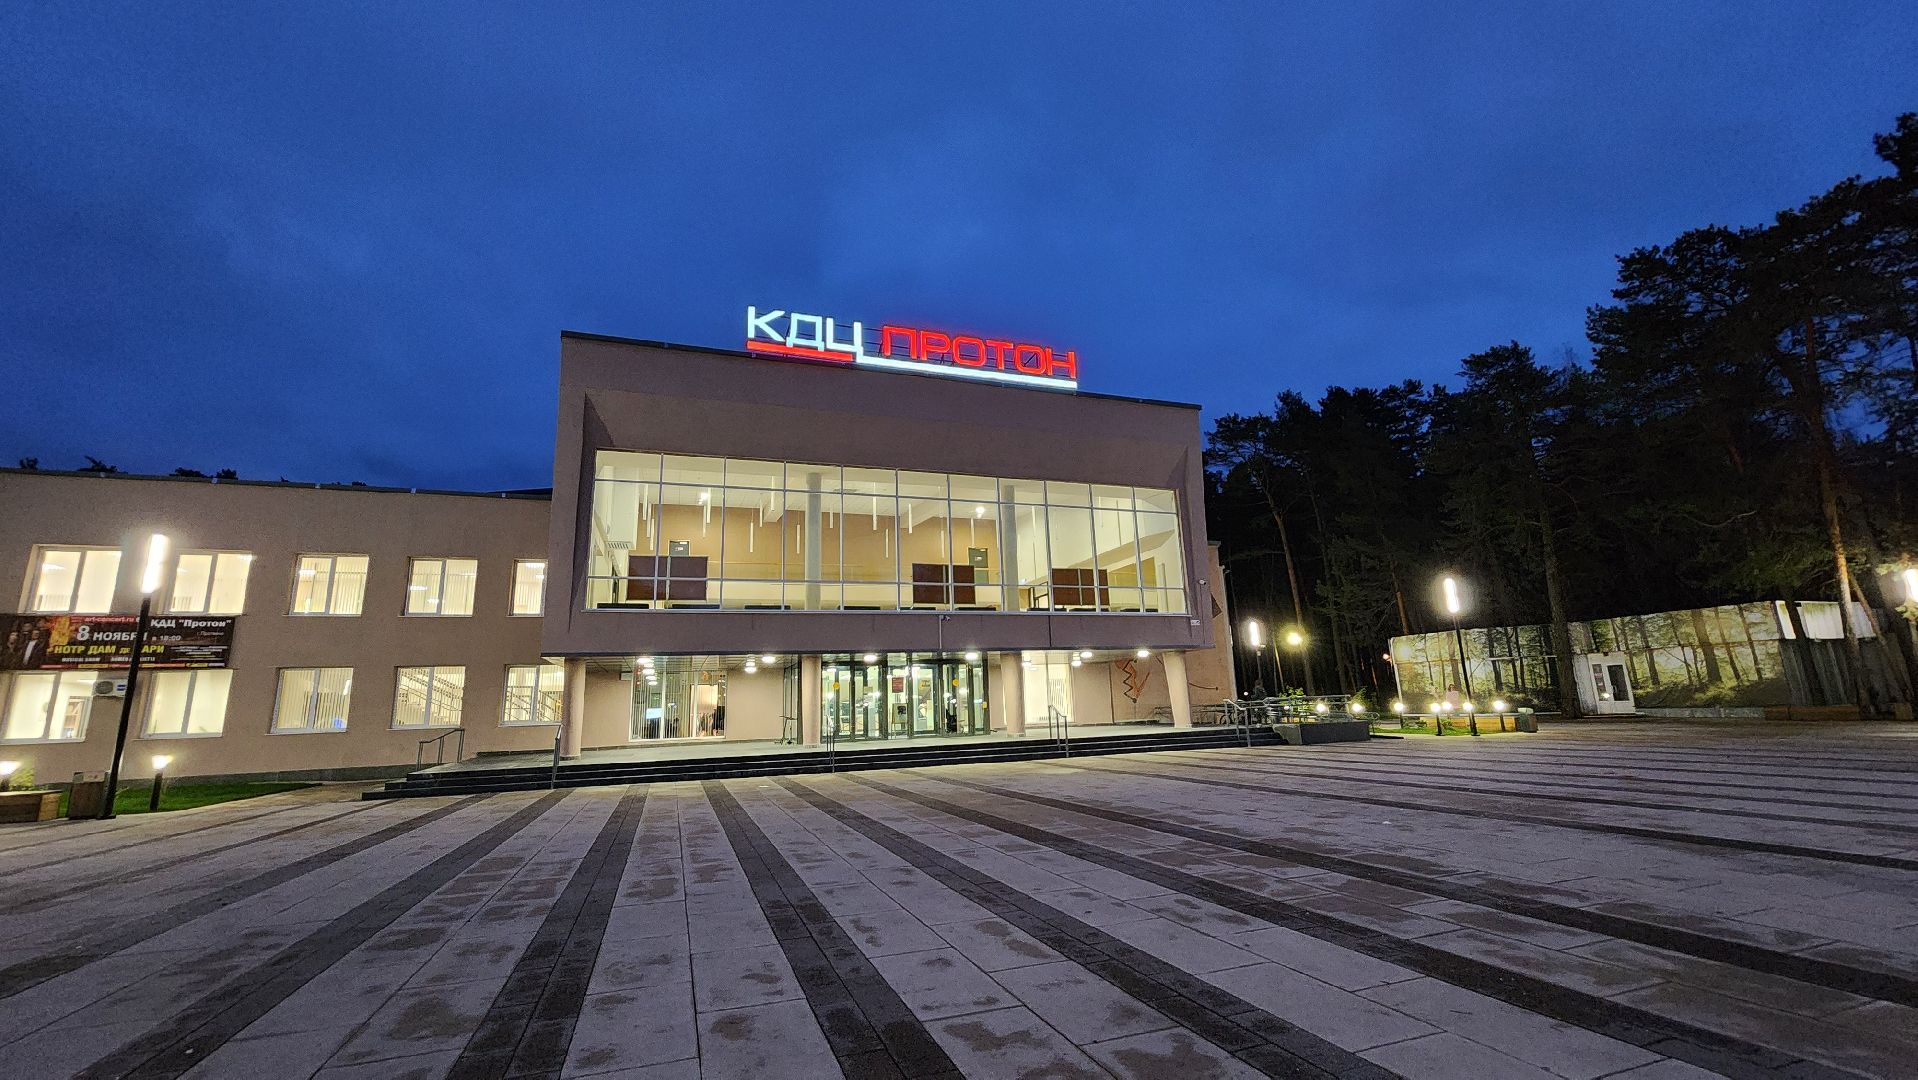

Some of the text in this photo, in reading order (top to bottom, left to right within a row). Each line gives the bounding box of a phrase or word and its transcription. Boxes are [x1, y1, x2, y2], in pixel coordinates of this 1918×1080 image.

[747, 305, 1077, 379] КДЦ ПРОТОН
[150, 619, 176, 628] КДЦ
[179, 619, 232, 629] "Протон"
[76, 625, 90, 641] 8
[54, 645, 86, 654] НОТР
[87, 645, 117, 655] ДАМ
